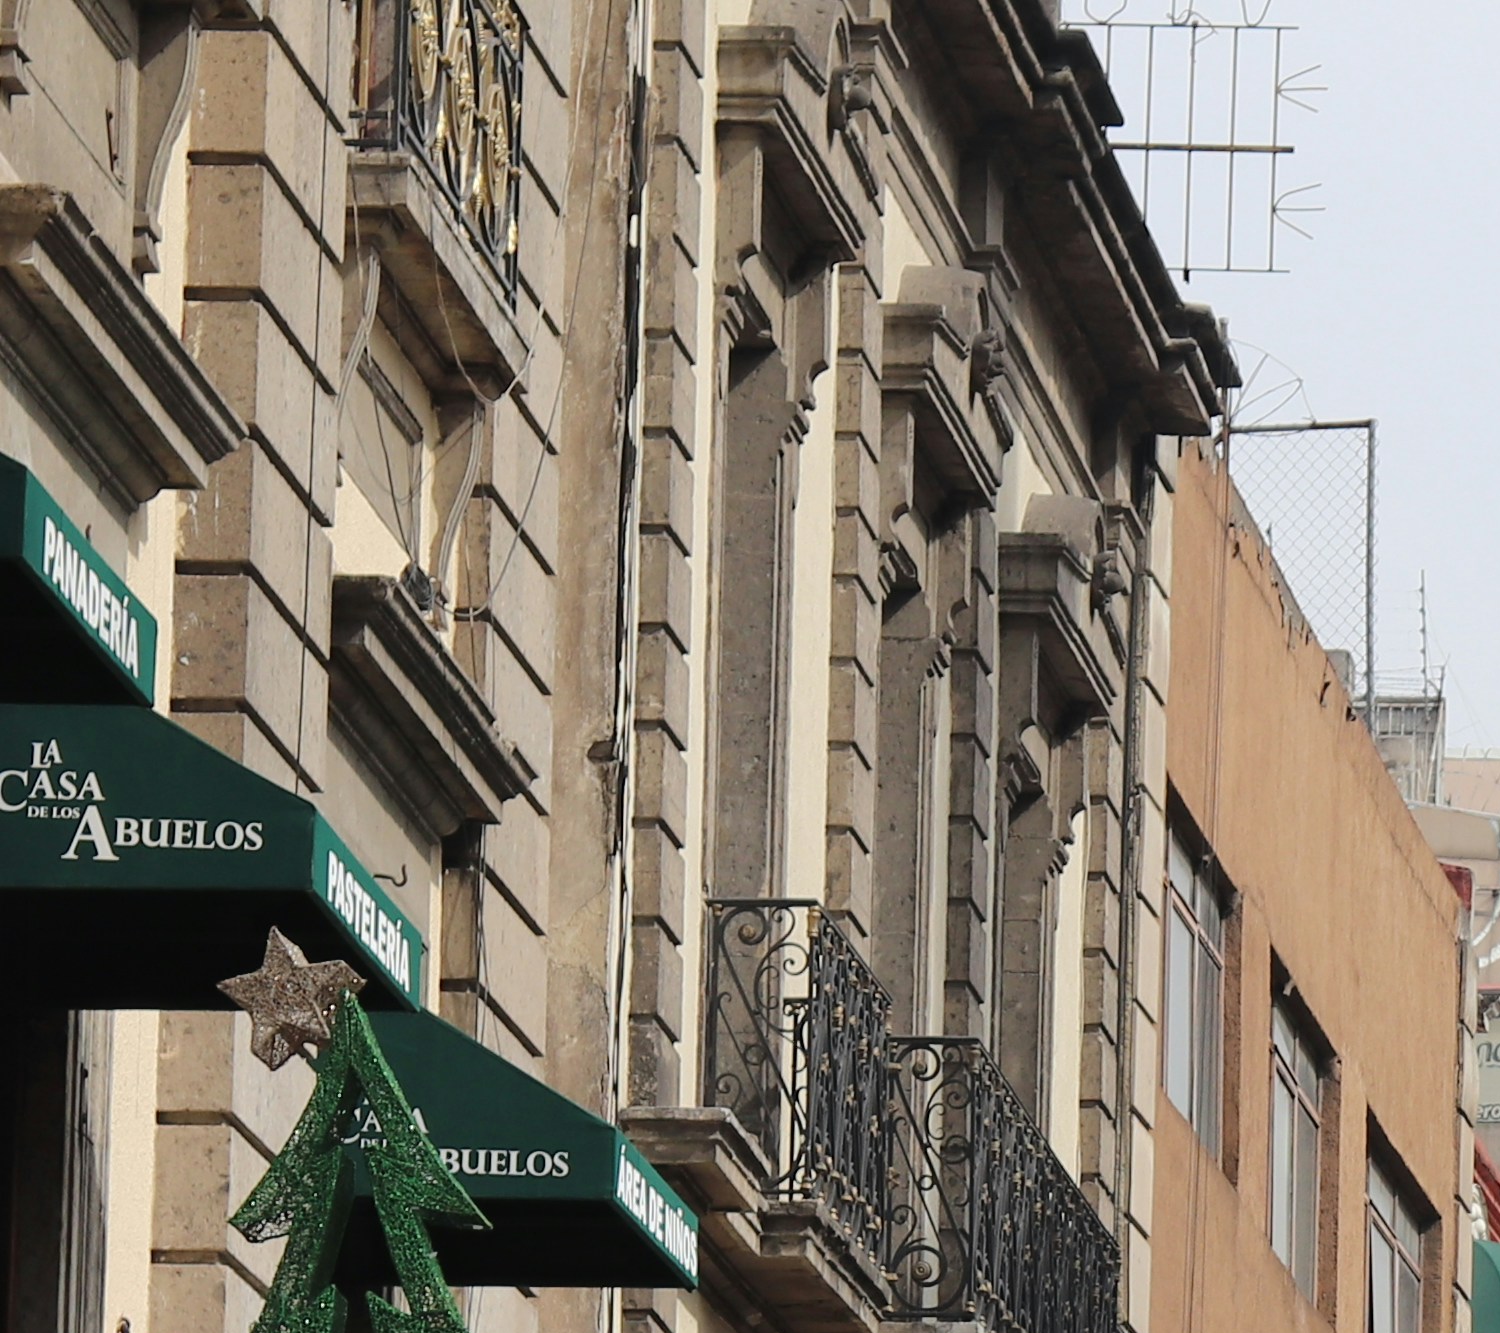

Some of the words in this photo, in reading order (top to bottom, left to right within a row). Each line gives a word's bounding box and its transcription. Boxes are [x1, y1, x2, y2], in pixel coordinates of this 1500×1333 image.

[43, 516, 140, 680] PANADERÍA
[31, 739, 63, 769] LA
[0, 769, 106, 812] CASA
[27, 805, 49, 818] DE
[52, 806, 81, 819] LOS
[61, 805, 264, 861] ABUELOS
[326, 850, 411, 994] PASTELERÍA
[438, 1148, 570, 1177] BUELOS
[617, 1144, 647, 1226] ÁREA
[648, 1186, 664, 1243] DE
[664, 1203, 698, 1278] NIÑOS
